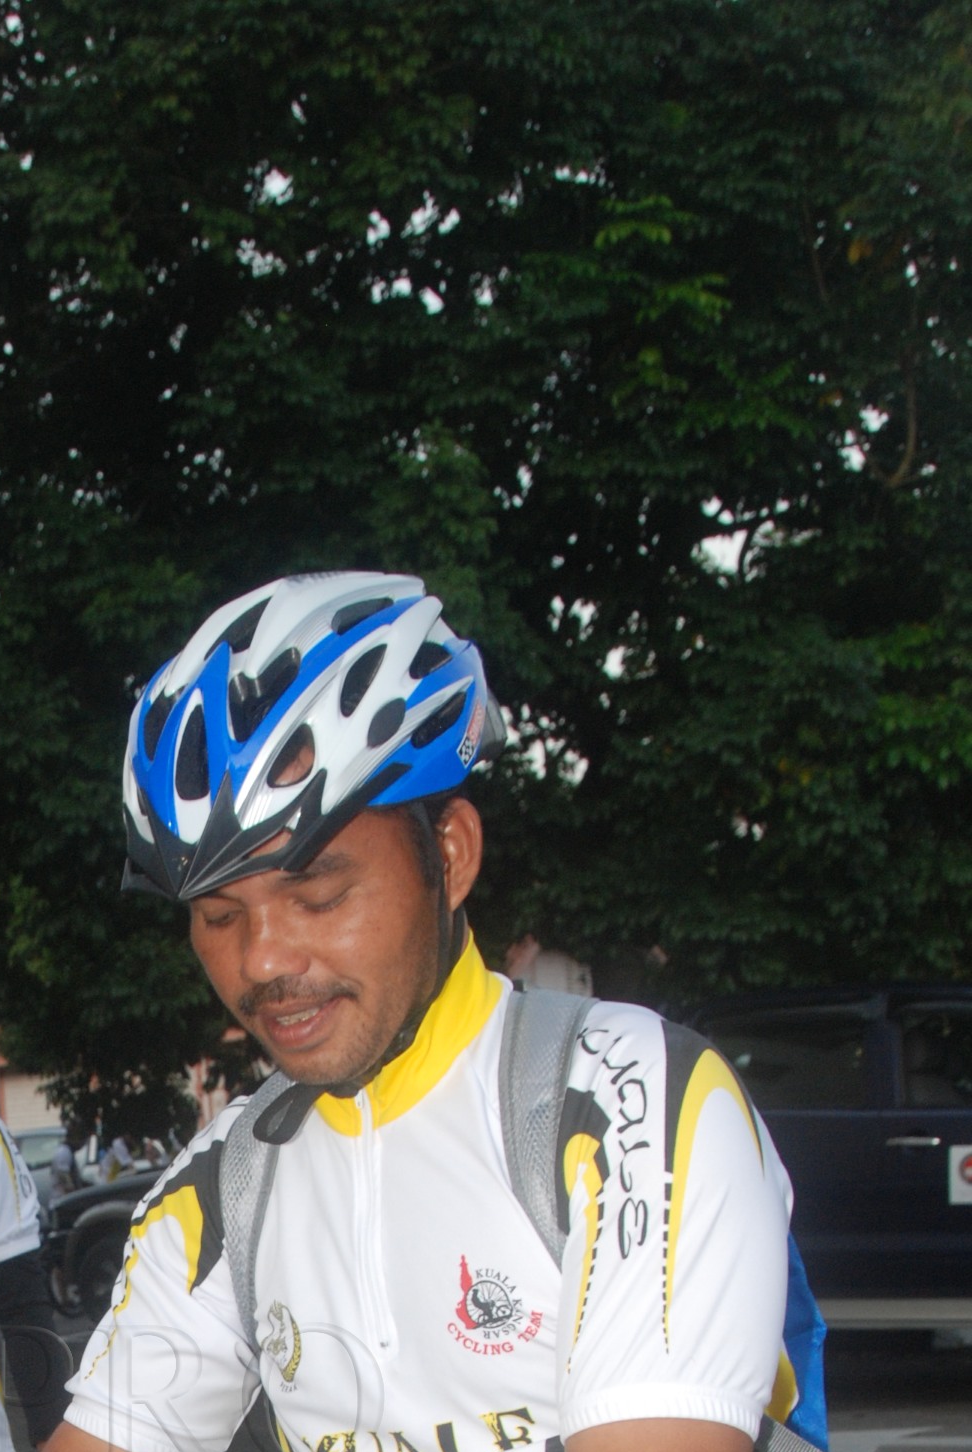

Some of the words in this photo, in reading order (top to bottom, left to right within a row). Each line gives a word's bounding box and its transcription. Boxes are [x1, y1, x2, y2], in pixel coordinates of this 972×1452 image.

[576, 1027, 651, 1261] KUALE
[475, 1268, 517, 1293] KUALA
[483, 1297, 525, 1340] KNGSAR
[446, 1322, 515, 1356] CYCLING
